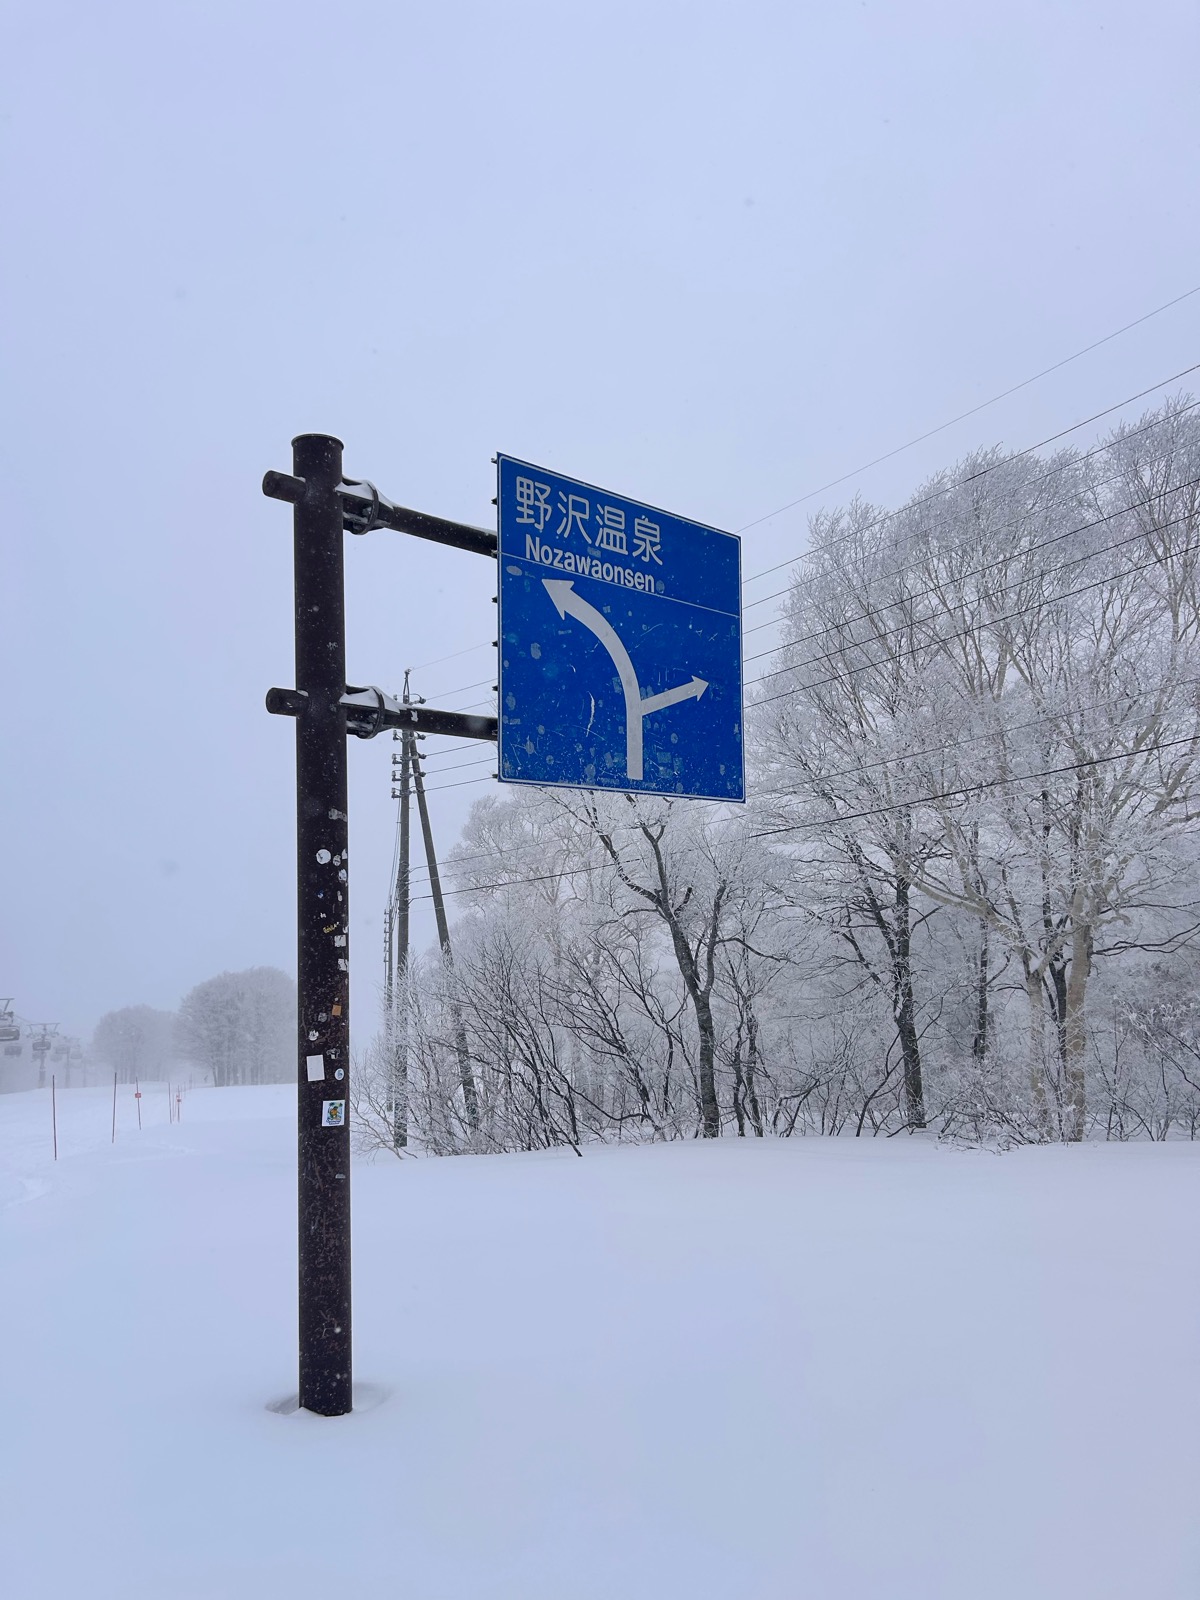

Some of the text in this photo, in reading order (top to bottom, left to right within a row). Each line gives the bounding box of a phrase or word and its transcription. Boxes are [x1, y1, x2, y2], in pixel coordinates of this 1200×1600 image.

[516, 476, 663, 566] 野沢温泉
[525, 534, 655, 593] Nozawaonsen
